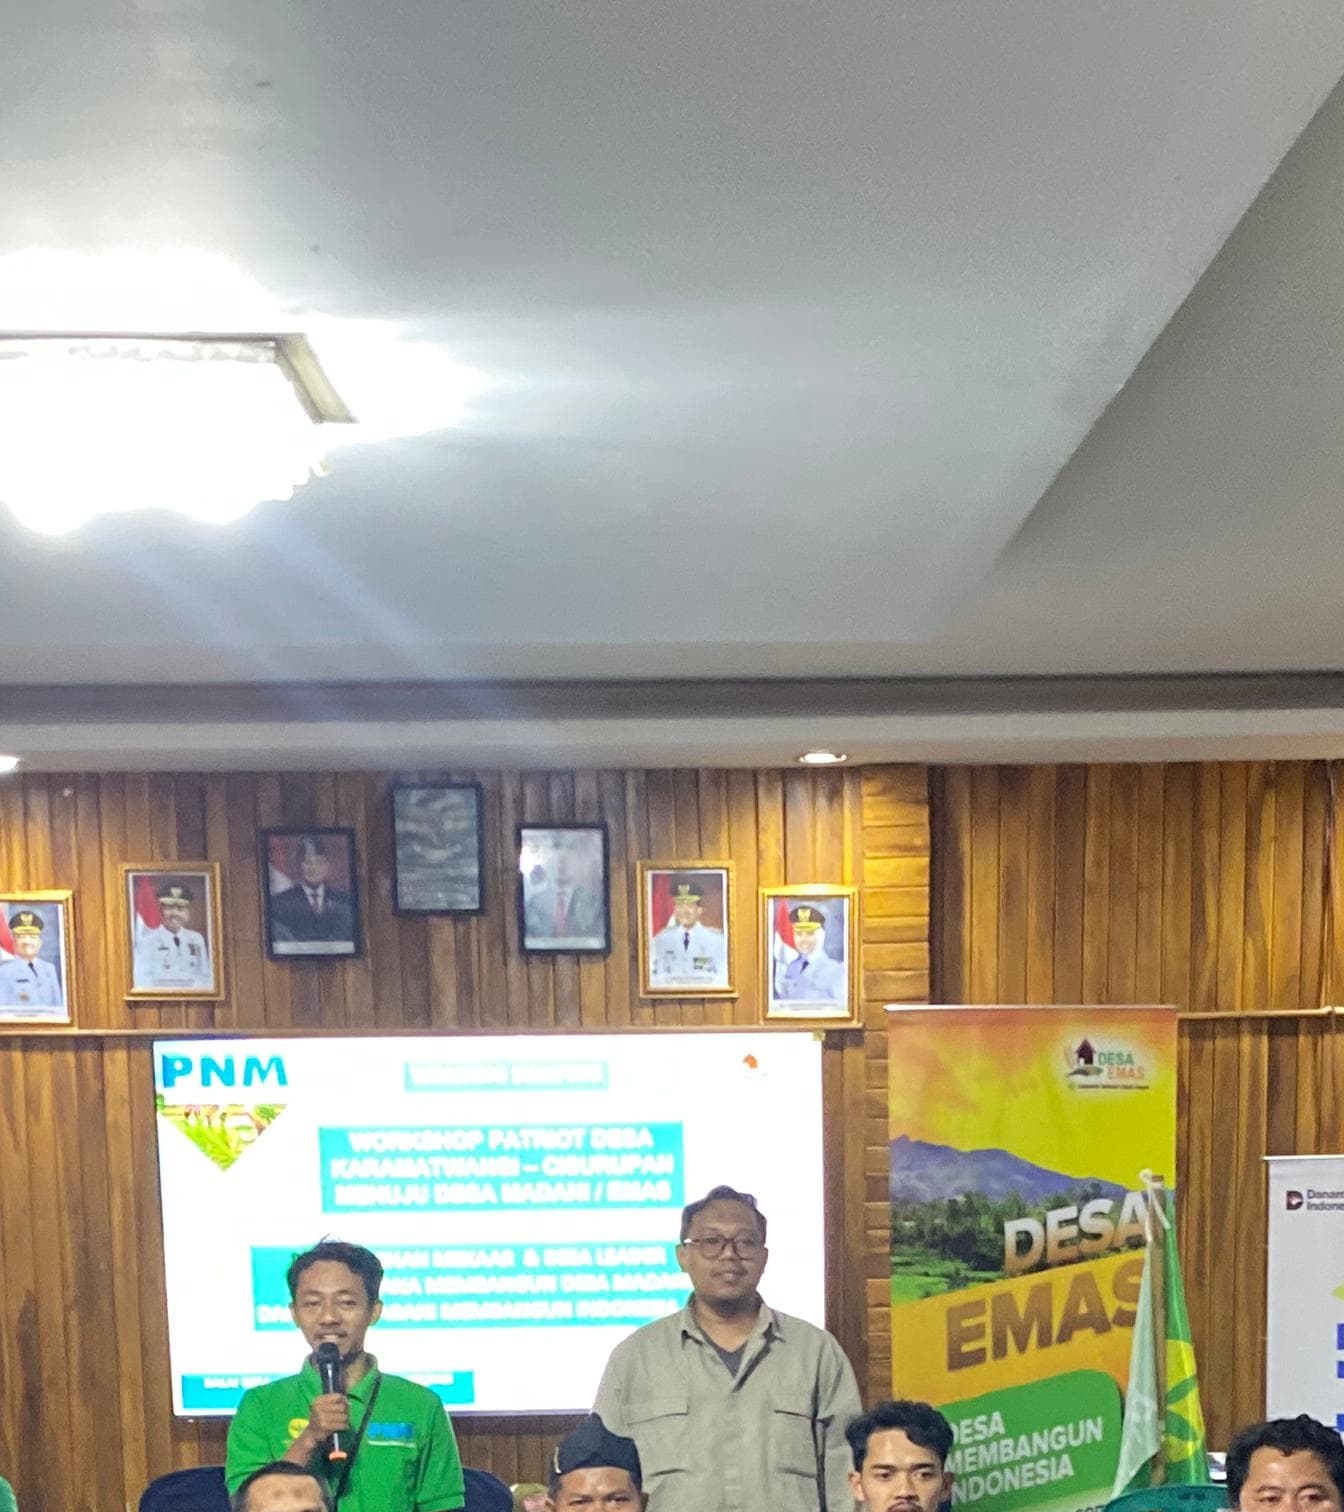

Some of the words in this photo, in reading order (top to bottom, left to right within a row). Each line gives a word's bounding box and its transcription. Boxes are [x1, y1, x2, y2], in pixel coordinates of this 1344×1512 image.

[162, 1054, 288, 1088] PNM
[1097, 1052, 1134, 1066] DESA
[1003, 1191, 1153, 1276] DESA
[946, 1257, 1143, 1373] EMAS
[950, 1454, 1074, 1506] NDONESIA
